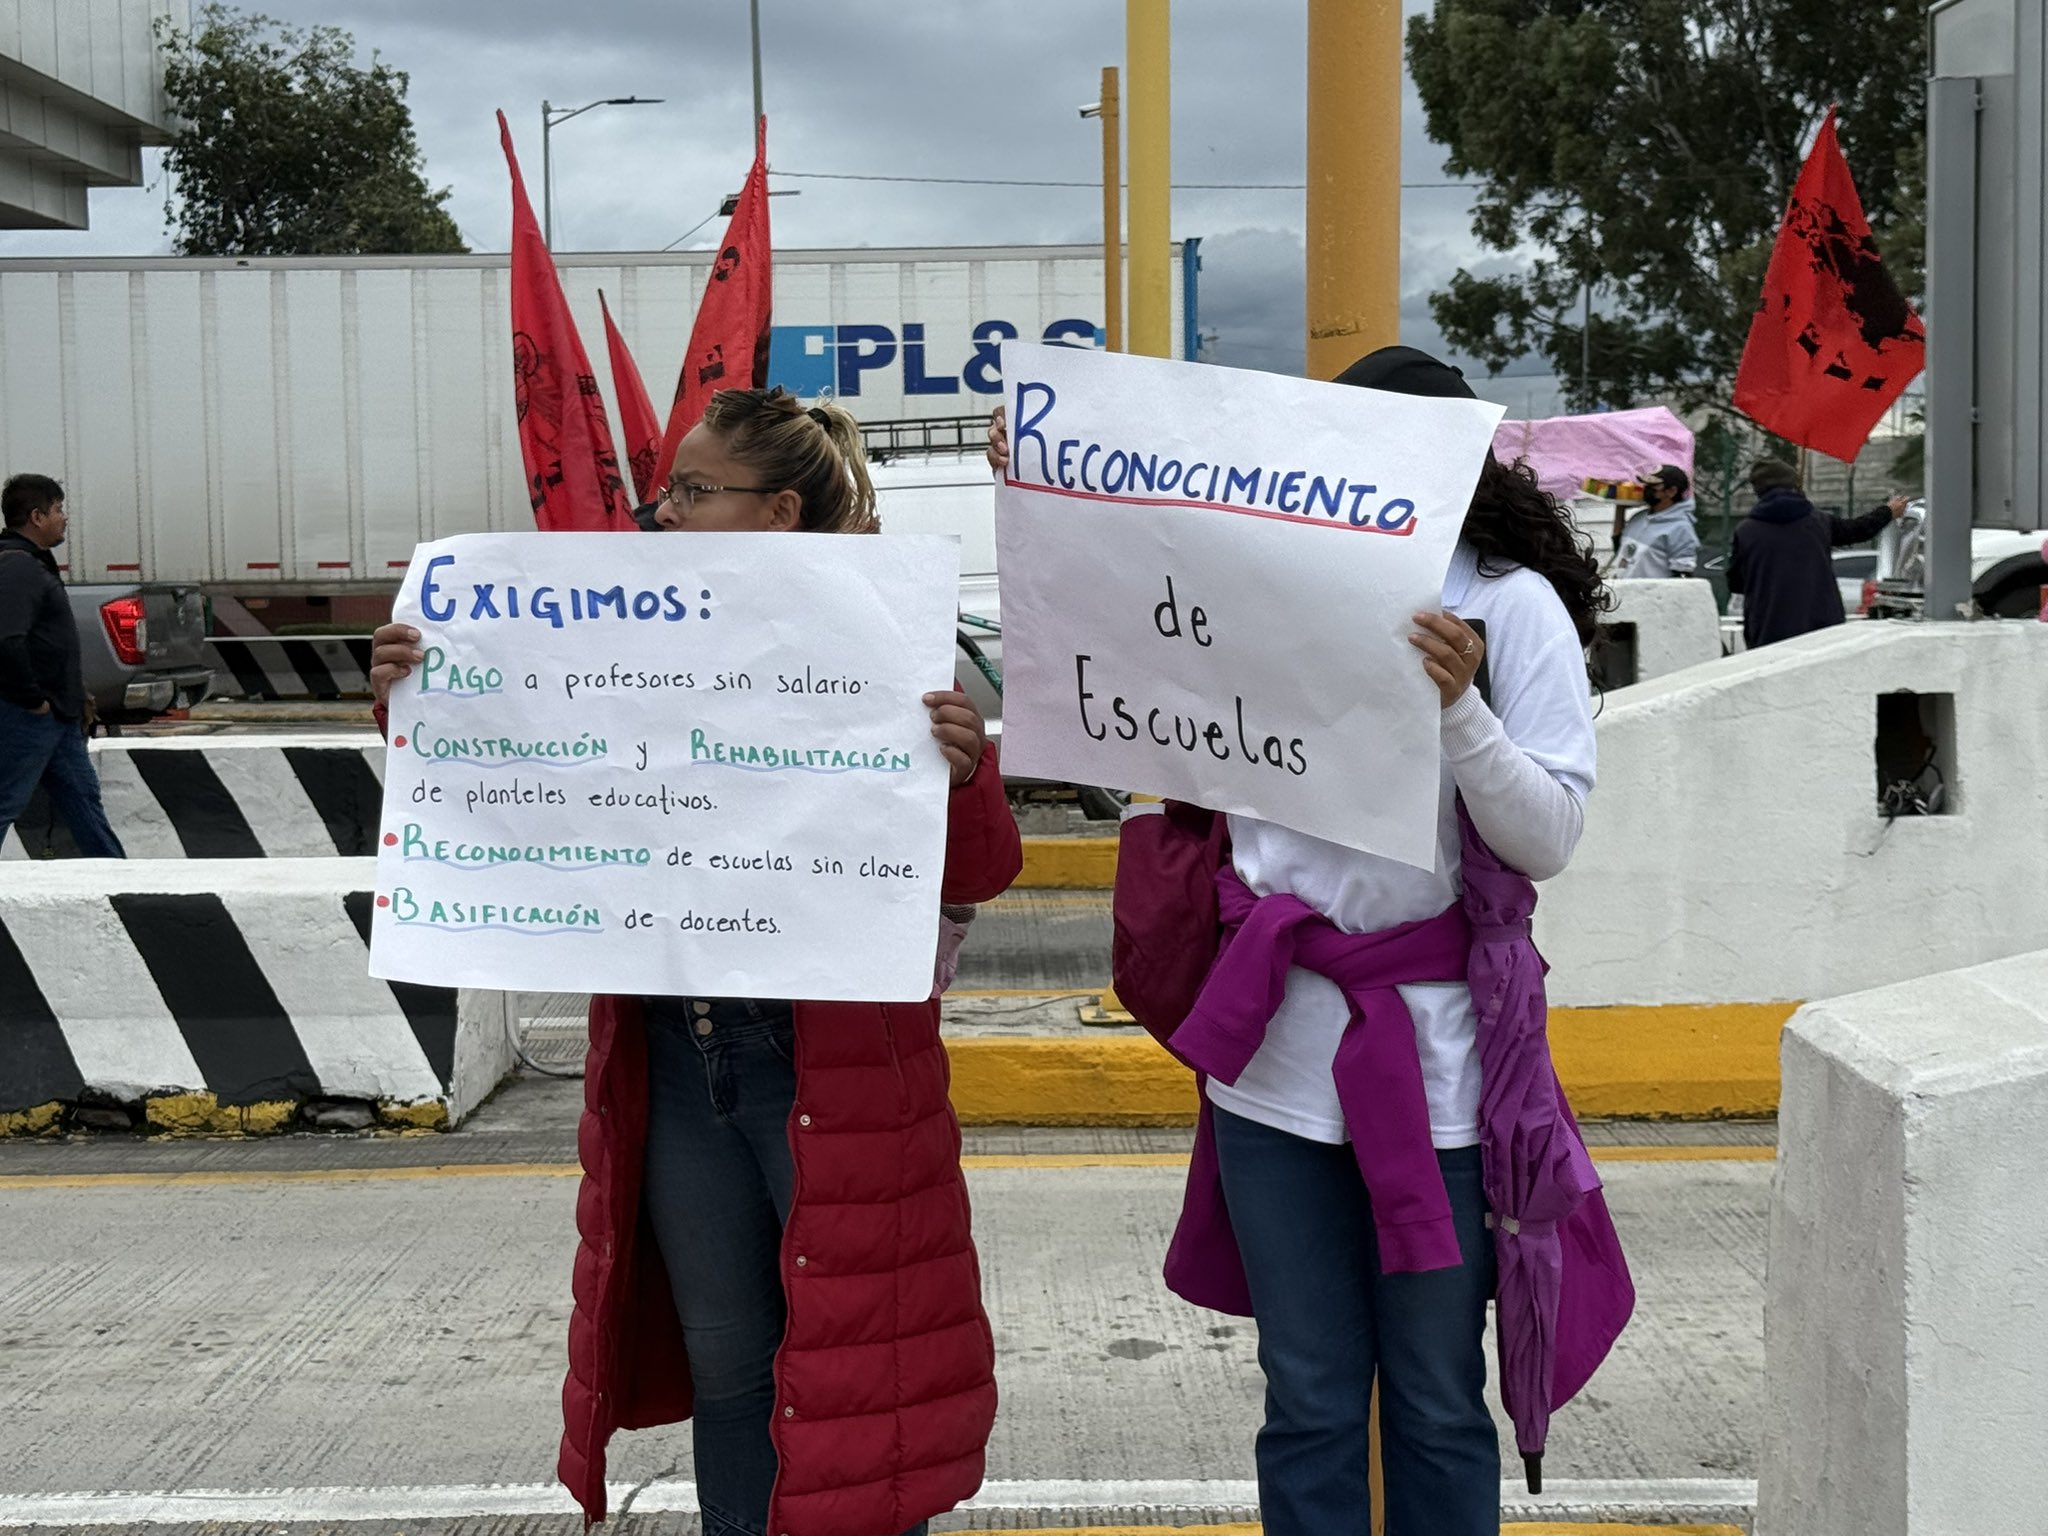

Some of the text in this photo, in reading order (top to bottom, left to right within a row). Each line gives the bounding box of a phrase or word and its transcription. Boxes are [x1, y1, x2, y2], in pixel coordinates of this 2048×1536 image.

[1012, 382, 1416, 530] RECONOCIMIENTO
[420, 555, 712, 628] EXIGIMOS:
[1154, 575, 1213, 648] de
[420, 646, 503, 692] PAGO
[524, 673, 539, 690] a
[565, 663, 696, 700] profesores
[712, 673, 753, 691] sin
[1075, 654, 1308, 776] Escuelas
[411, 721, 911, 771] CONSTRUCCIÓN y REHABILITACIÓN
[412, 778, 718, 815] de planteles educativos.
[403, 823, 920, 880] RECONOCIMIENTO de escuelas sin clave.
[392, 887, 782, 934] BASIFICACIÓN de docentes.
